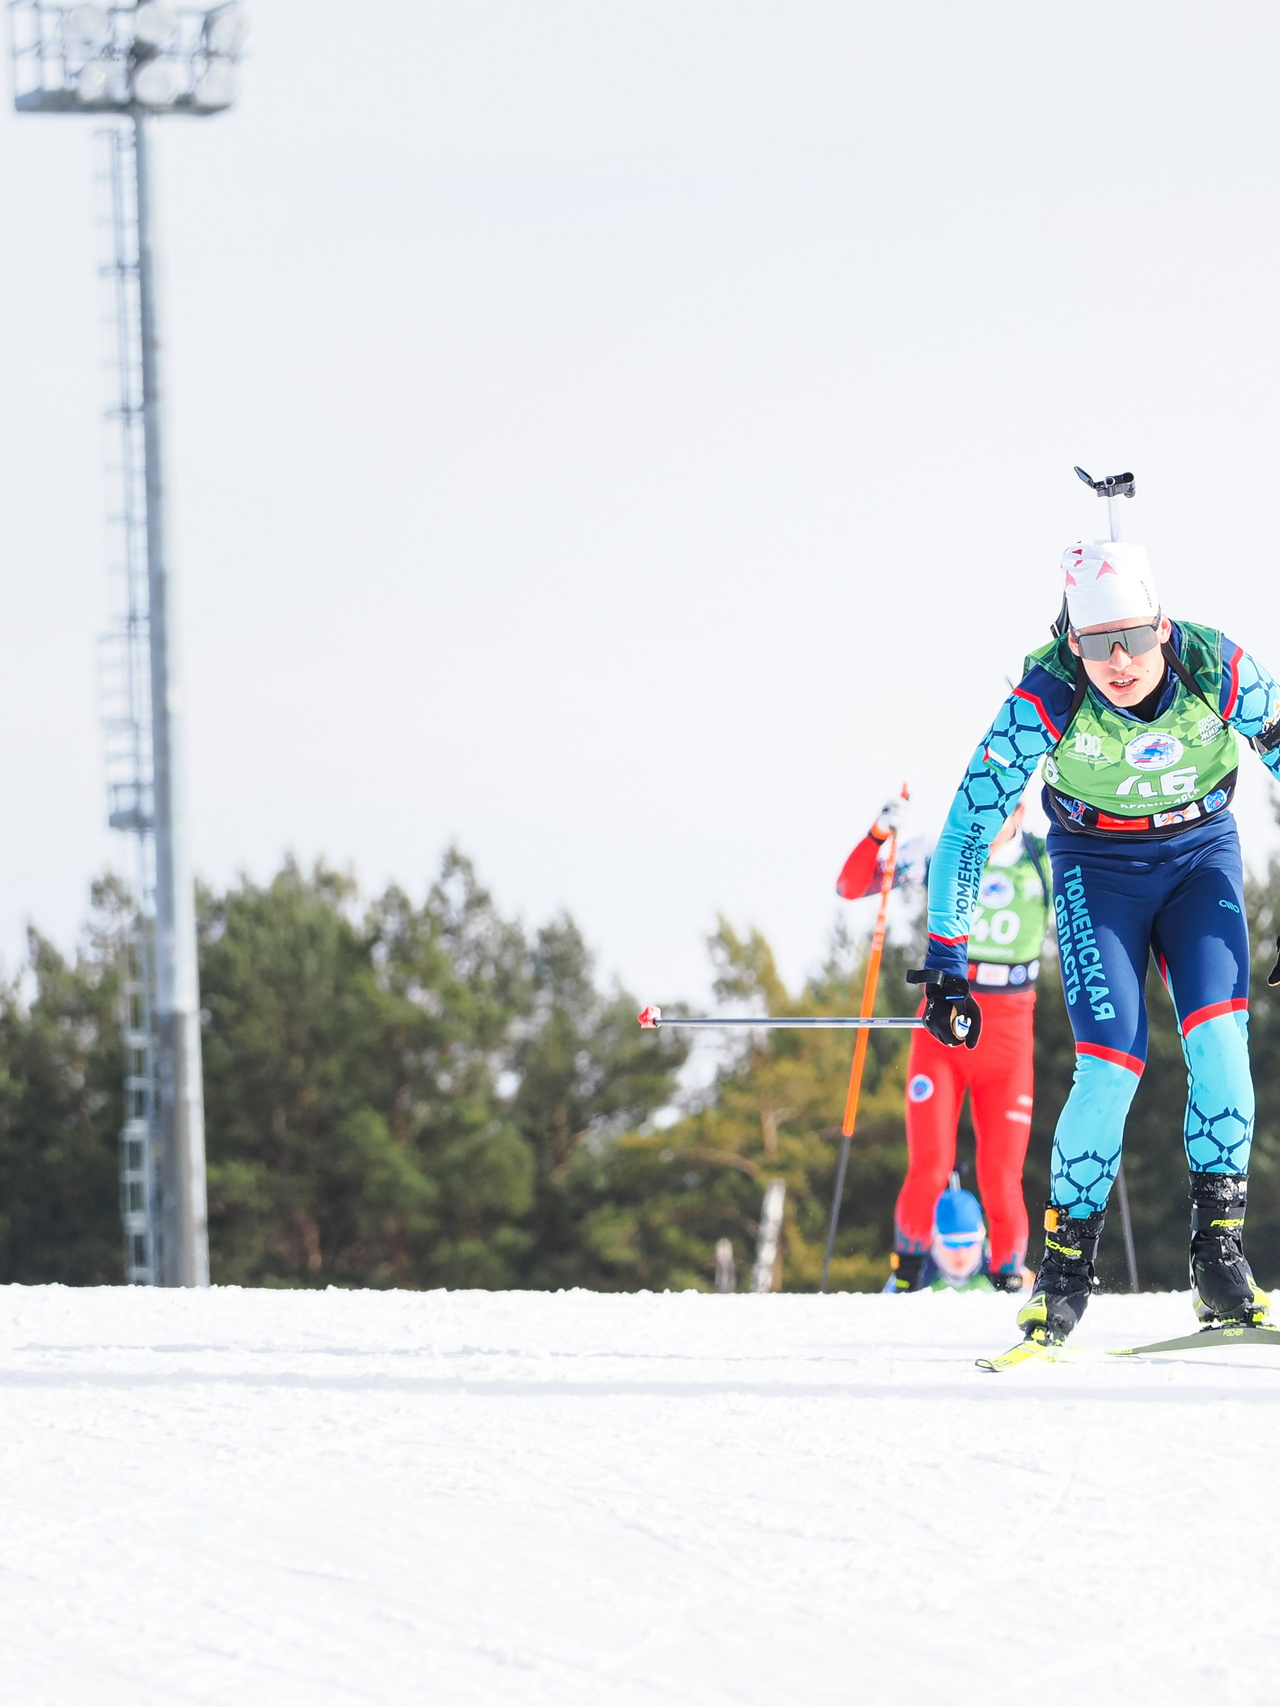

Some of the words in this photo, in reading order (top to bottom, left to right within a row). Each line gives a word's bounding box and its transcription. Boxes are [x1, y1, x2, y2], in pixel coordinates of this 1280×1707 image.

[969, 905, 1021, 945] 40
[1055, 894, 1081, 1006] ОБЛАСТЬ
[1063, 864, 1117, 1022] ТЮМЕНСКАЯ
